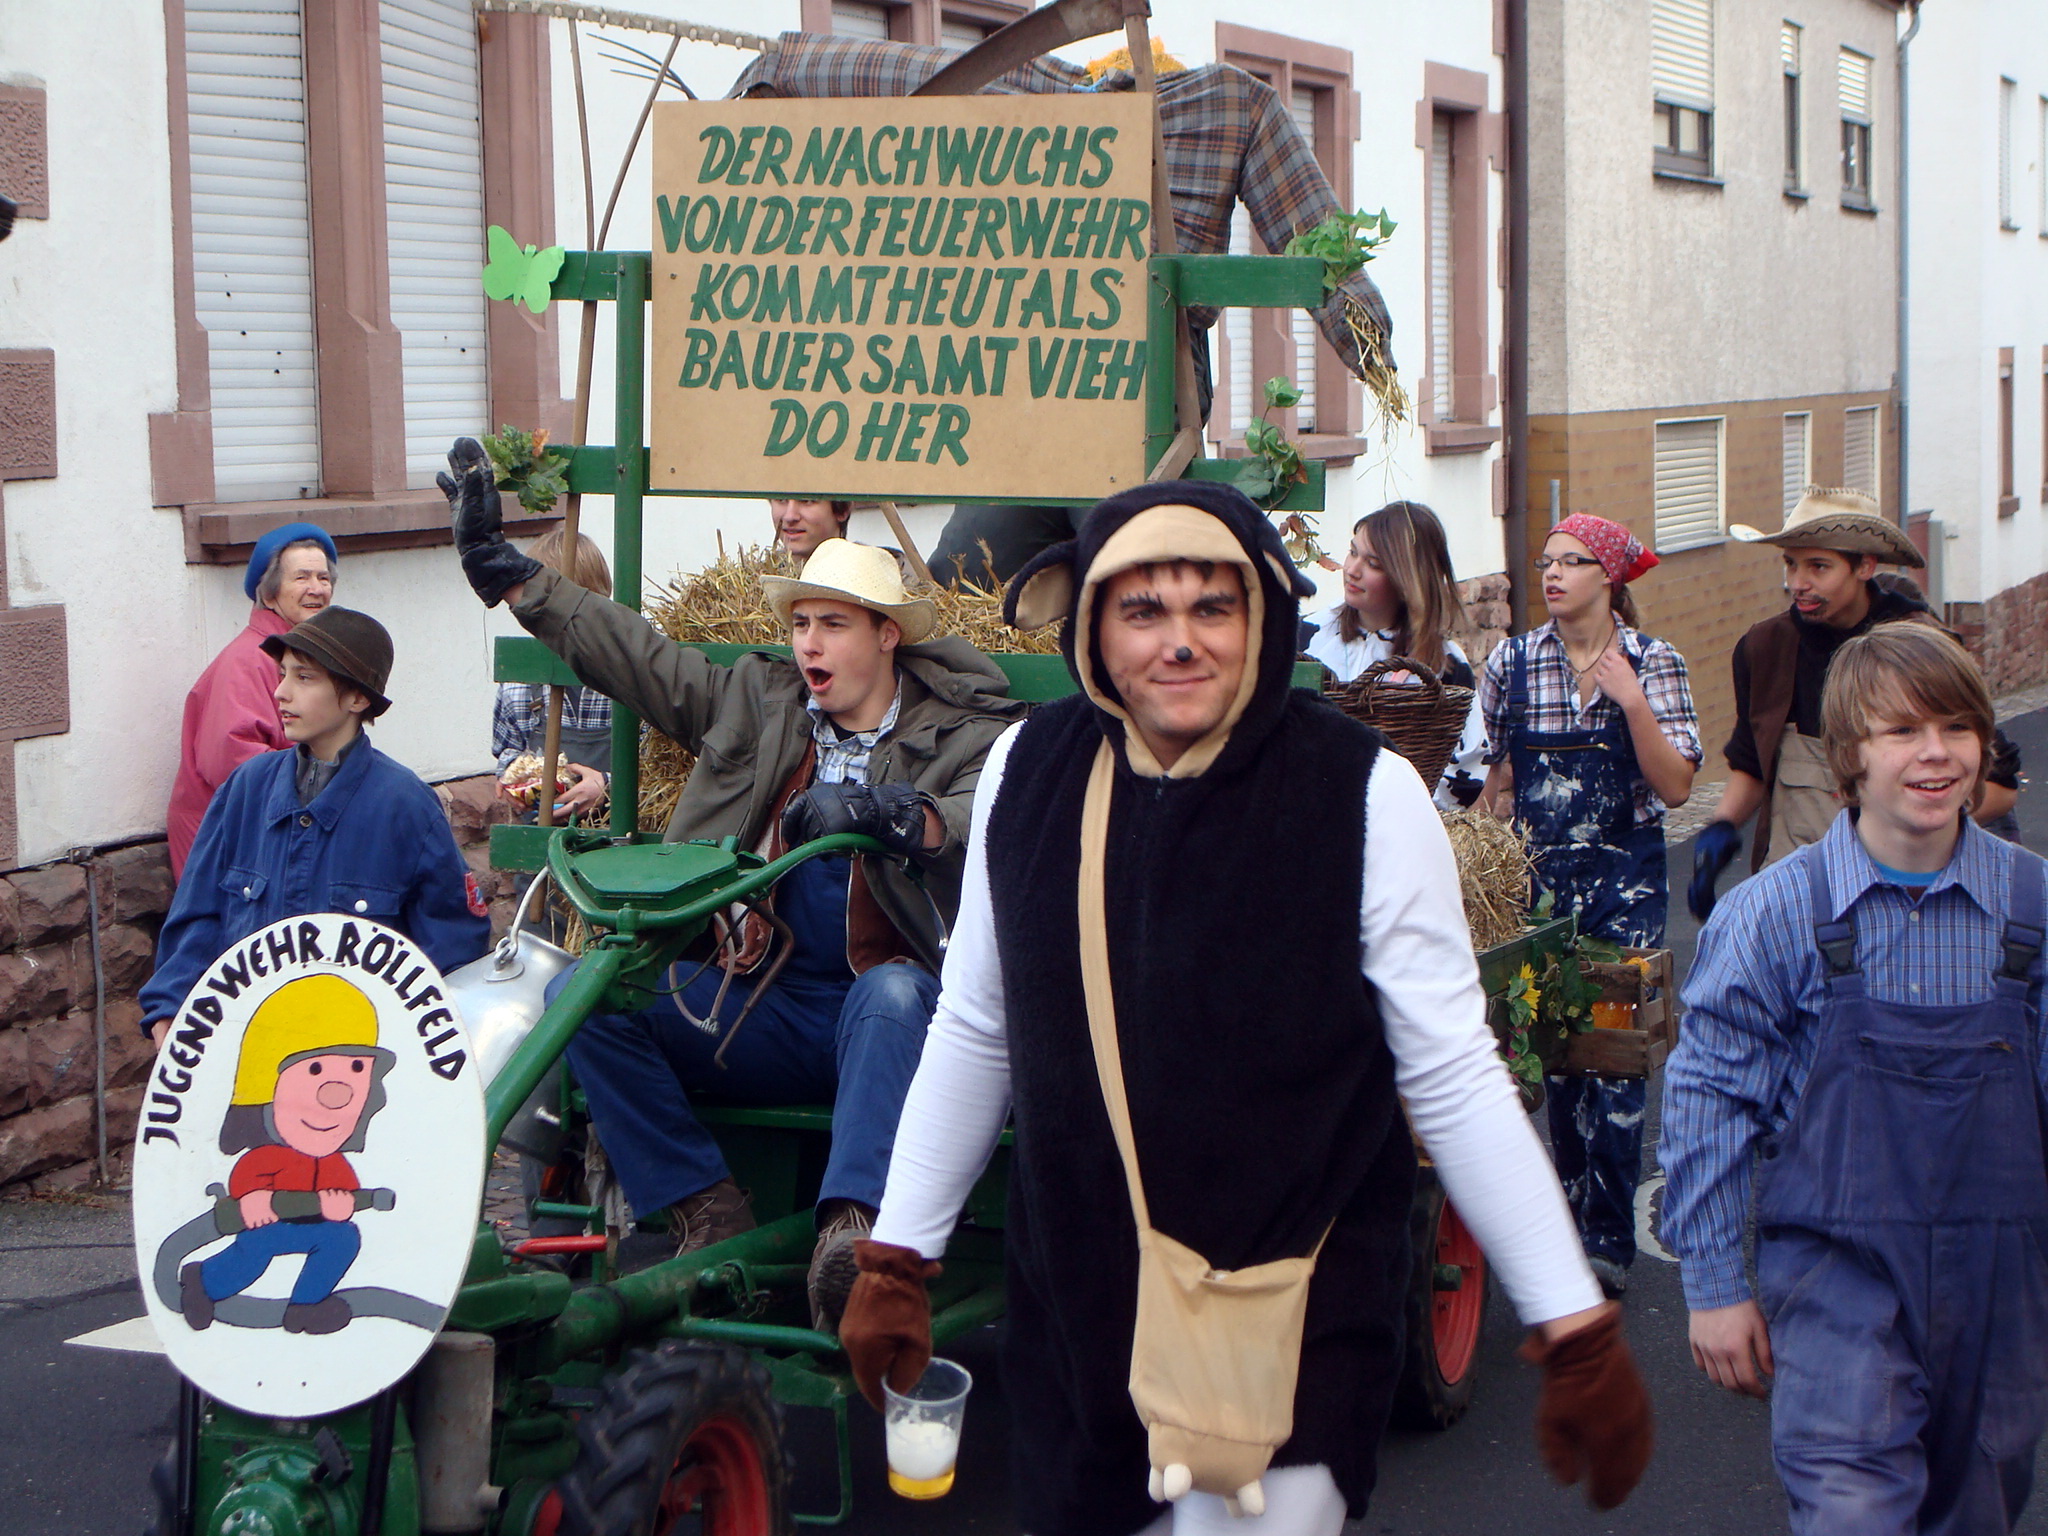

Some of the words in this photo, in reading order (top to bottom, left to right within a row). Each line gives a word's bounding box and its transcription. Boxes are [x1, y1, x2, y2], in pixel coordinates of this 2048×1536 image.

[698, 125, 793, 185] DER
[794, 125, 1118, 188] NACHWUCHS
[656, 195, 758, 254] VON
[752, 196, 854, 256] DER
[853, 196, 1150, 261] FEUERWEHR
[690, 263, 890, 325] KOMMT
[885, 267, 1028, 328] HEUT
[1020, 268, 1124, 330] ALS
[679, 328, 854, 394] BAUER
[860, 334, 1019, 396] SAMT
[1028, 336, 1147, 400] VIEH
[764, 398, 850, 458] DO
[854, 401, 971, 466] HER
[335, 922, 467, 1081] RÖLLFELD
